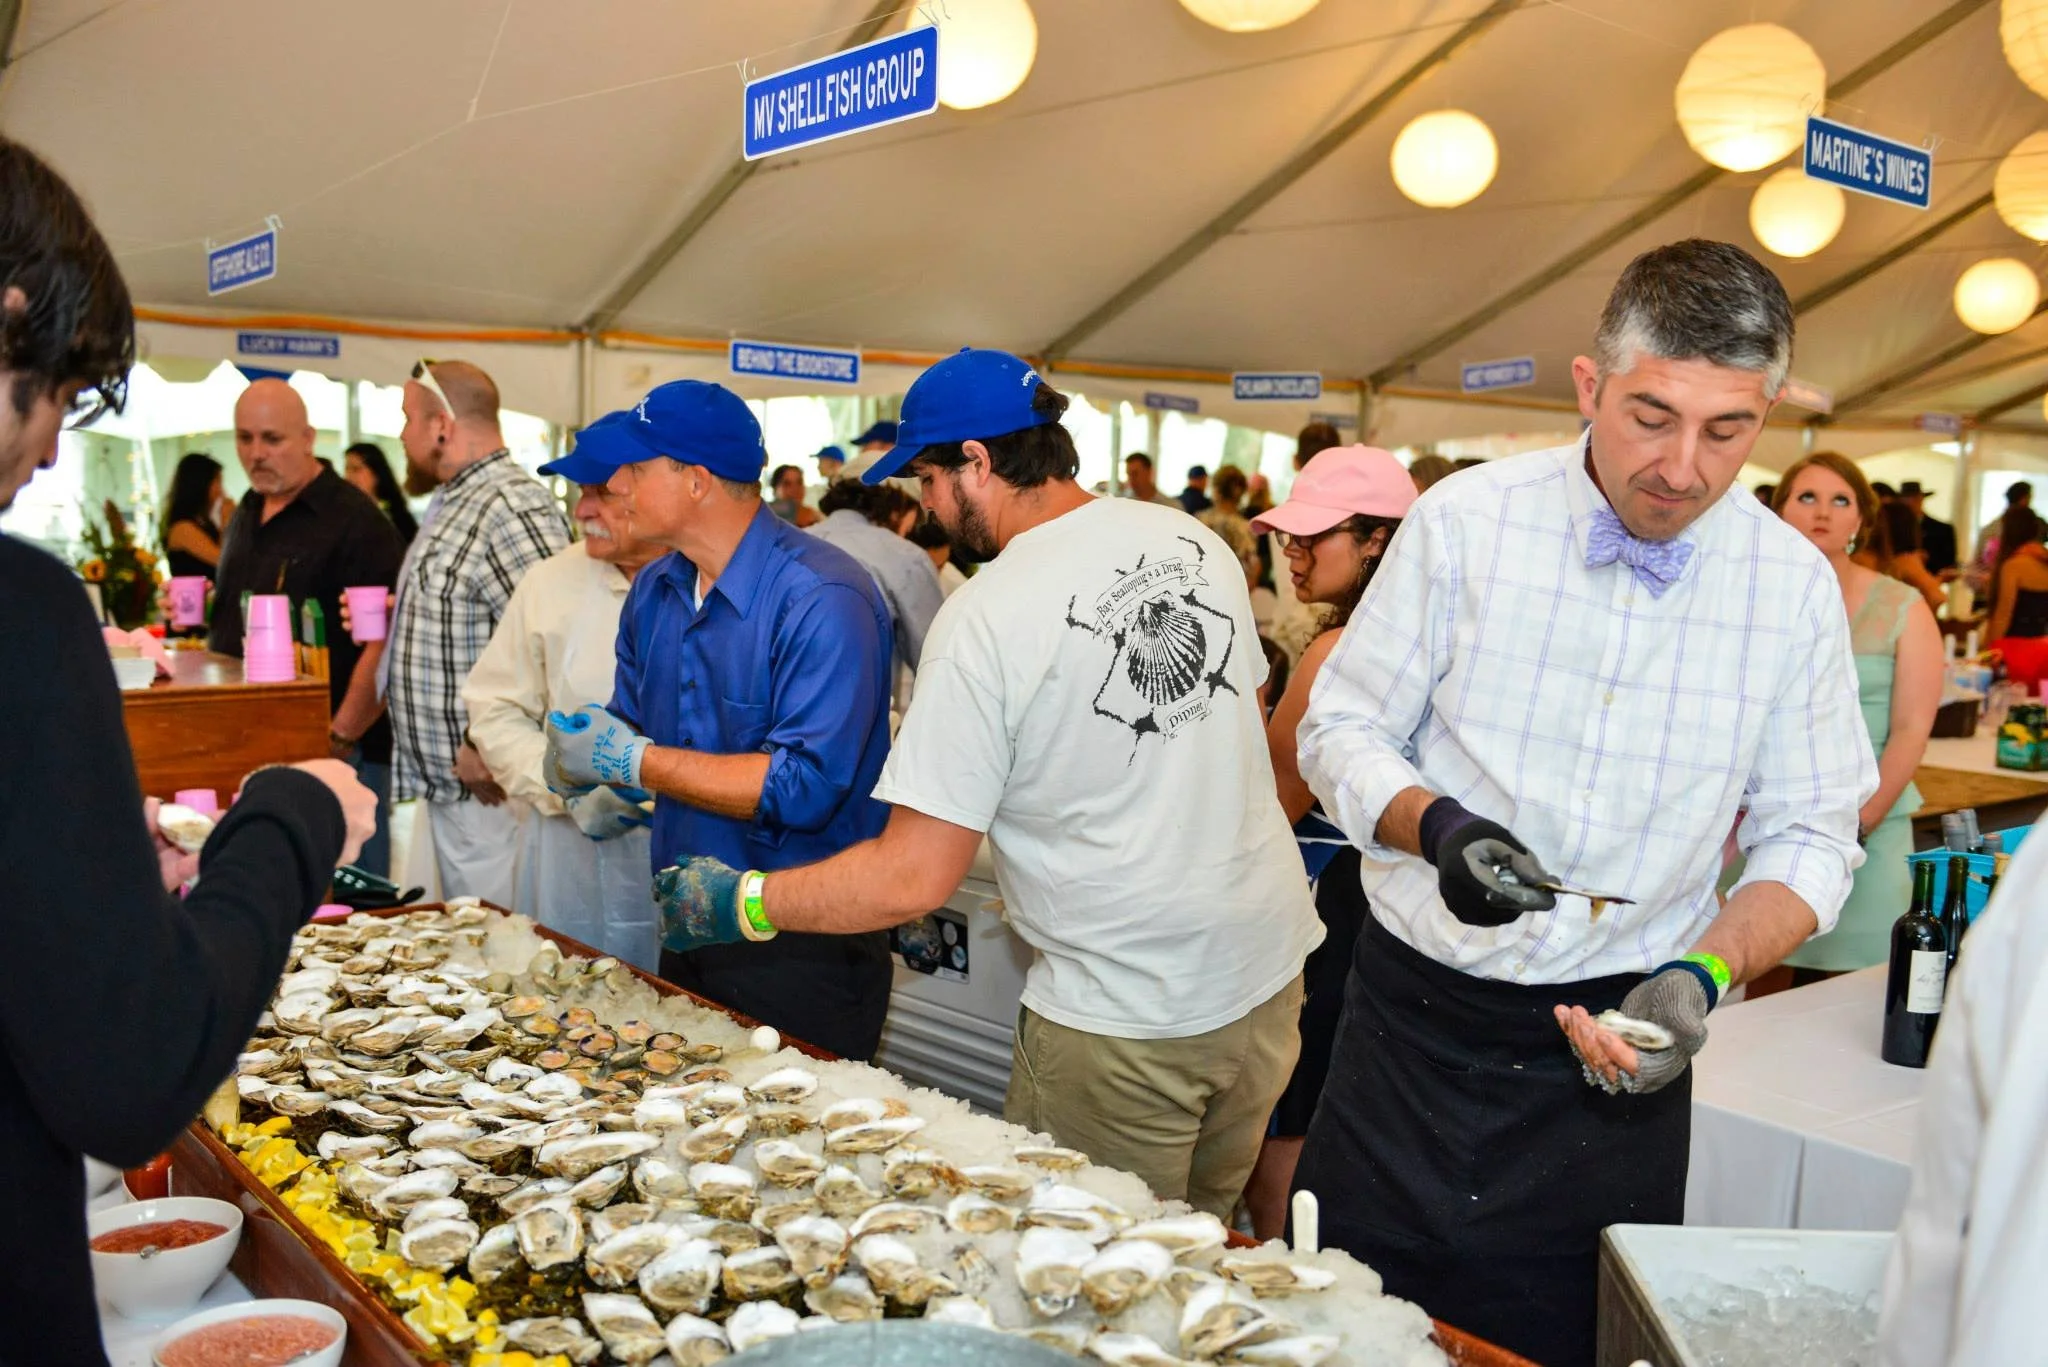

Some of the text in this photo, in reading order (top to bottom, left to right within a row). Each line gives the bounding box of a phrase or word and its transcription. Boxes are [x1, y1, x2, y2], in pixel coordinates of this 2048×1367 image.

[754, 47, 925, 140] MV SHELLFISH GROUP
[1811, 130, 1925, 195] MARTINE'S WINES
[1097, 562, 1184, 618] Bay Scalloping's a Drag
[1168, 701, 1205, 729] Dipnet
